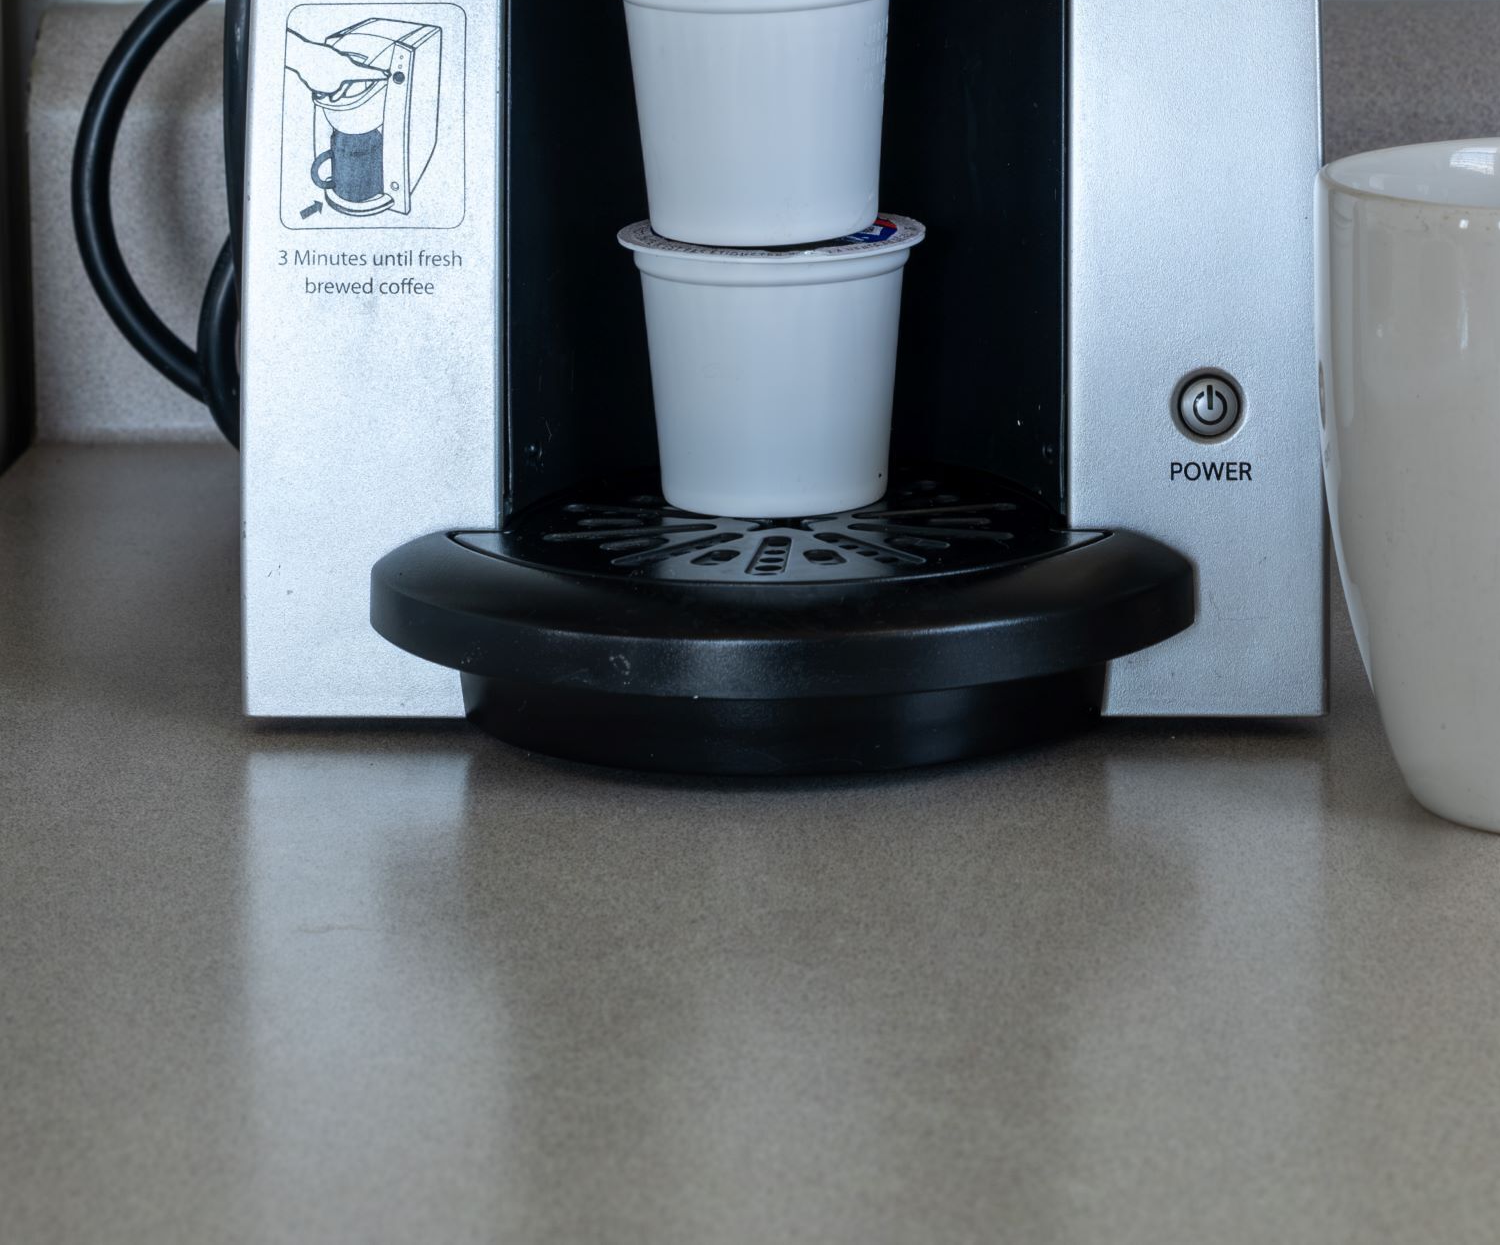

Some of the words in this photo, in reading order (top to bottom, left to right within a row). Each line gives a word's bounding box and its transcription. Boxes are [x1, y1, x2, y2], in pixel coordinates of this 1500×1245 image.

[277, 249, 289, 267] 3
[293, 249, 368, 267] Minutes
[372, 249, 414, 267] until
[417, 249, 463, 267] fresh
[304, 276, 374, 295] brewed
[378, 276, 435, 295] coffee
[1169, 460, 1253, 482] POWER
